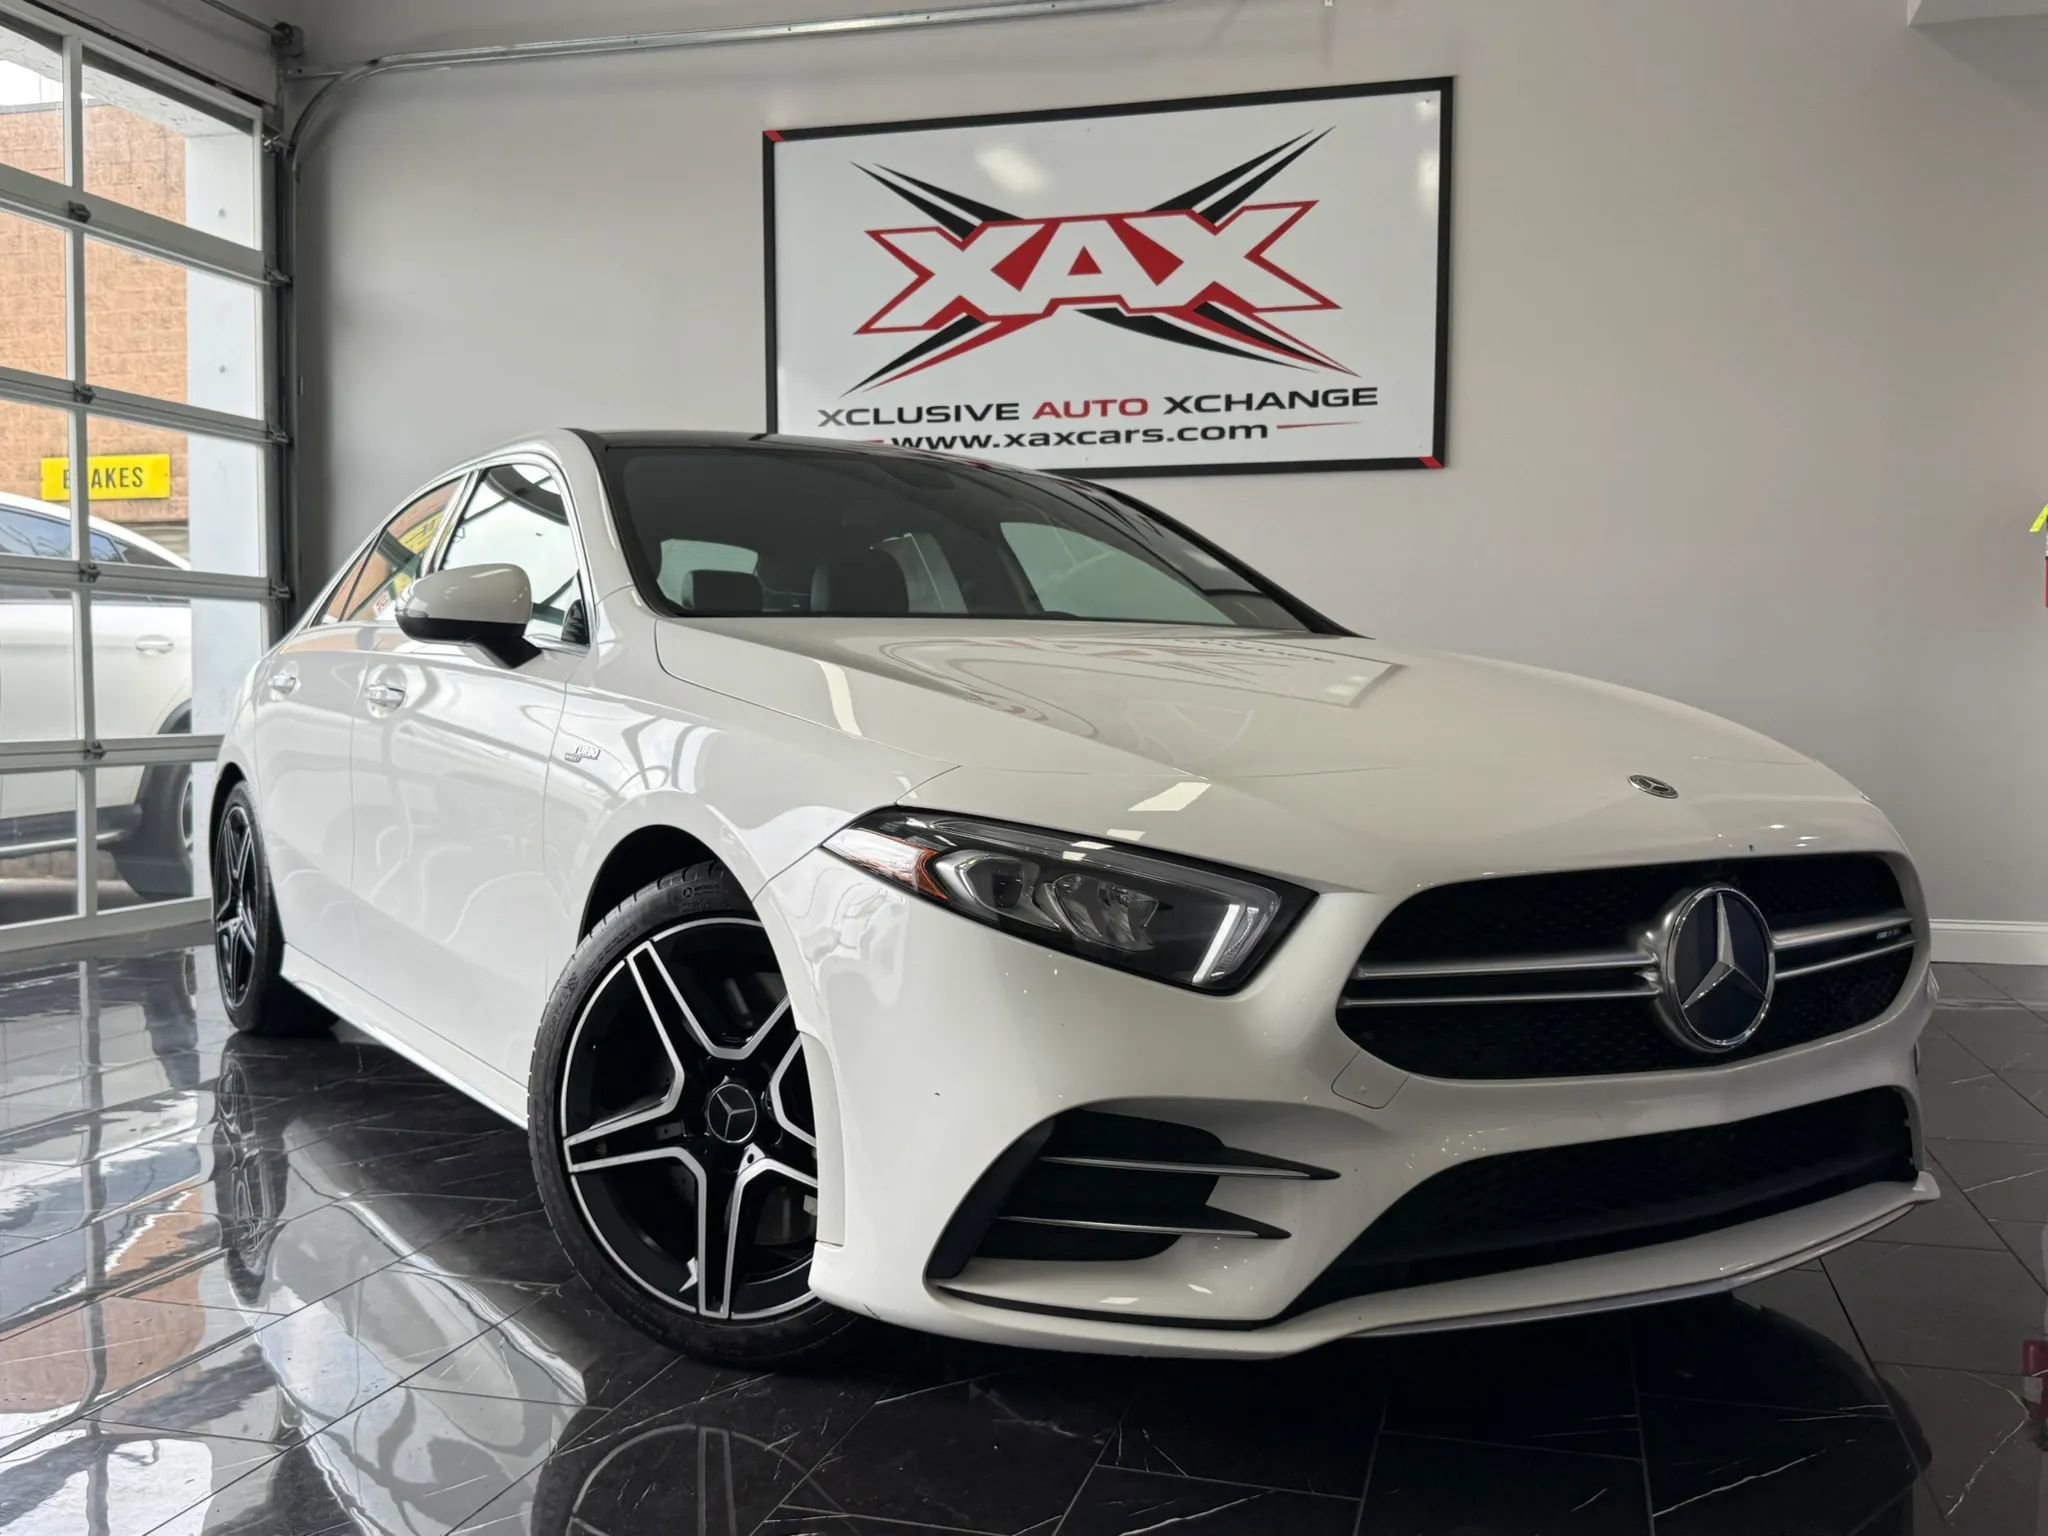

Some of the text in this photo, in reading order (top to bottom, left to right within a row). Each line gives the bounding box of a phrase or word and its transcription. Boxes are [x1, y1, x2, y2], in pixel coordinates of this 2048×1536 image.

[854, 199, 1342, 335] XAX
[817, 387, 1379, 428] XCLUSIVE AUTO XCHANGE
[891, 423, 1268, 451] www.xaxcars.com
[63, 466, 143, 489] BAKES
